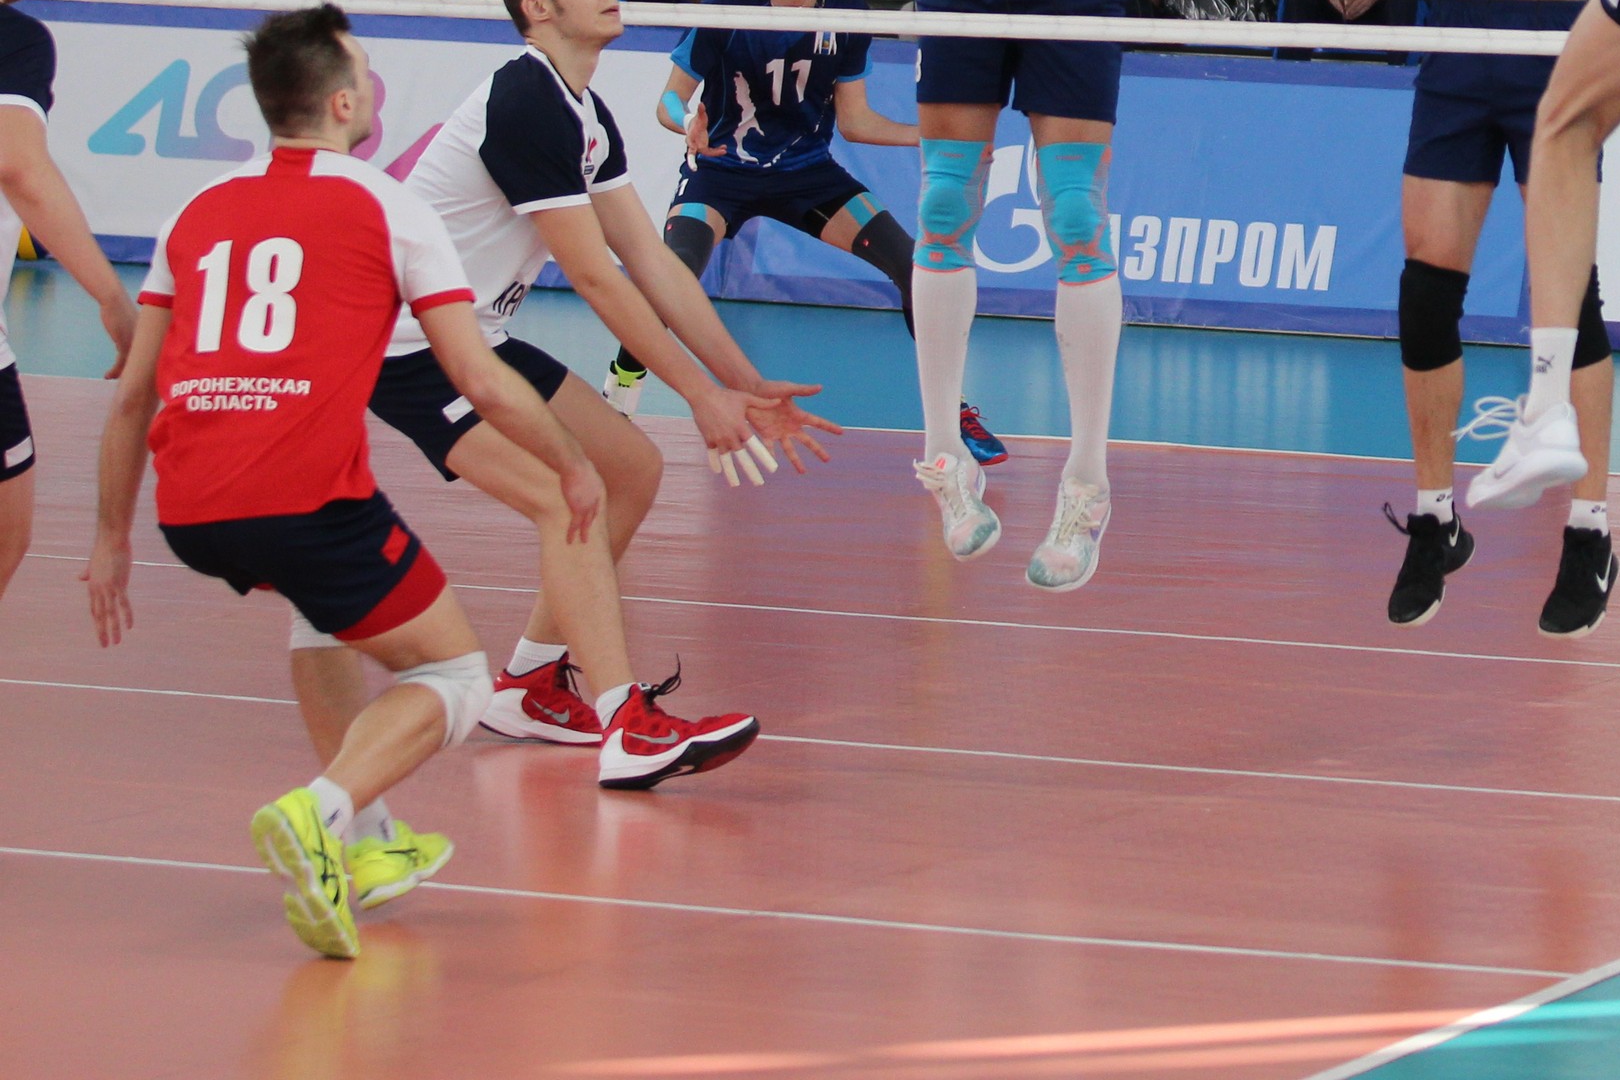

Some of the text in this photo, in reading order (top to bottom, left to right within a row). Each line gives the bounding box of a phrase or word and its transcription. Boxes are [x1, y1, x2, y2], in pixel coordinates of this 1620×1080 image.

[766, 58, 812, 106] 11
[196, 236, 305, 353] 18
[170, 377, 311, 399] ВОРОНЕЖСКАЯ
[186, 395, 278, 411] ОБЛАСТЬ
